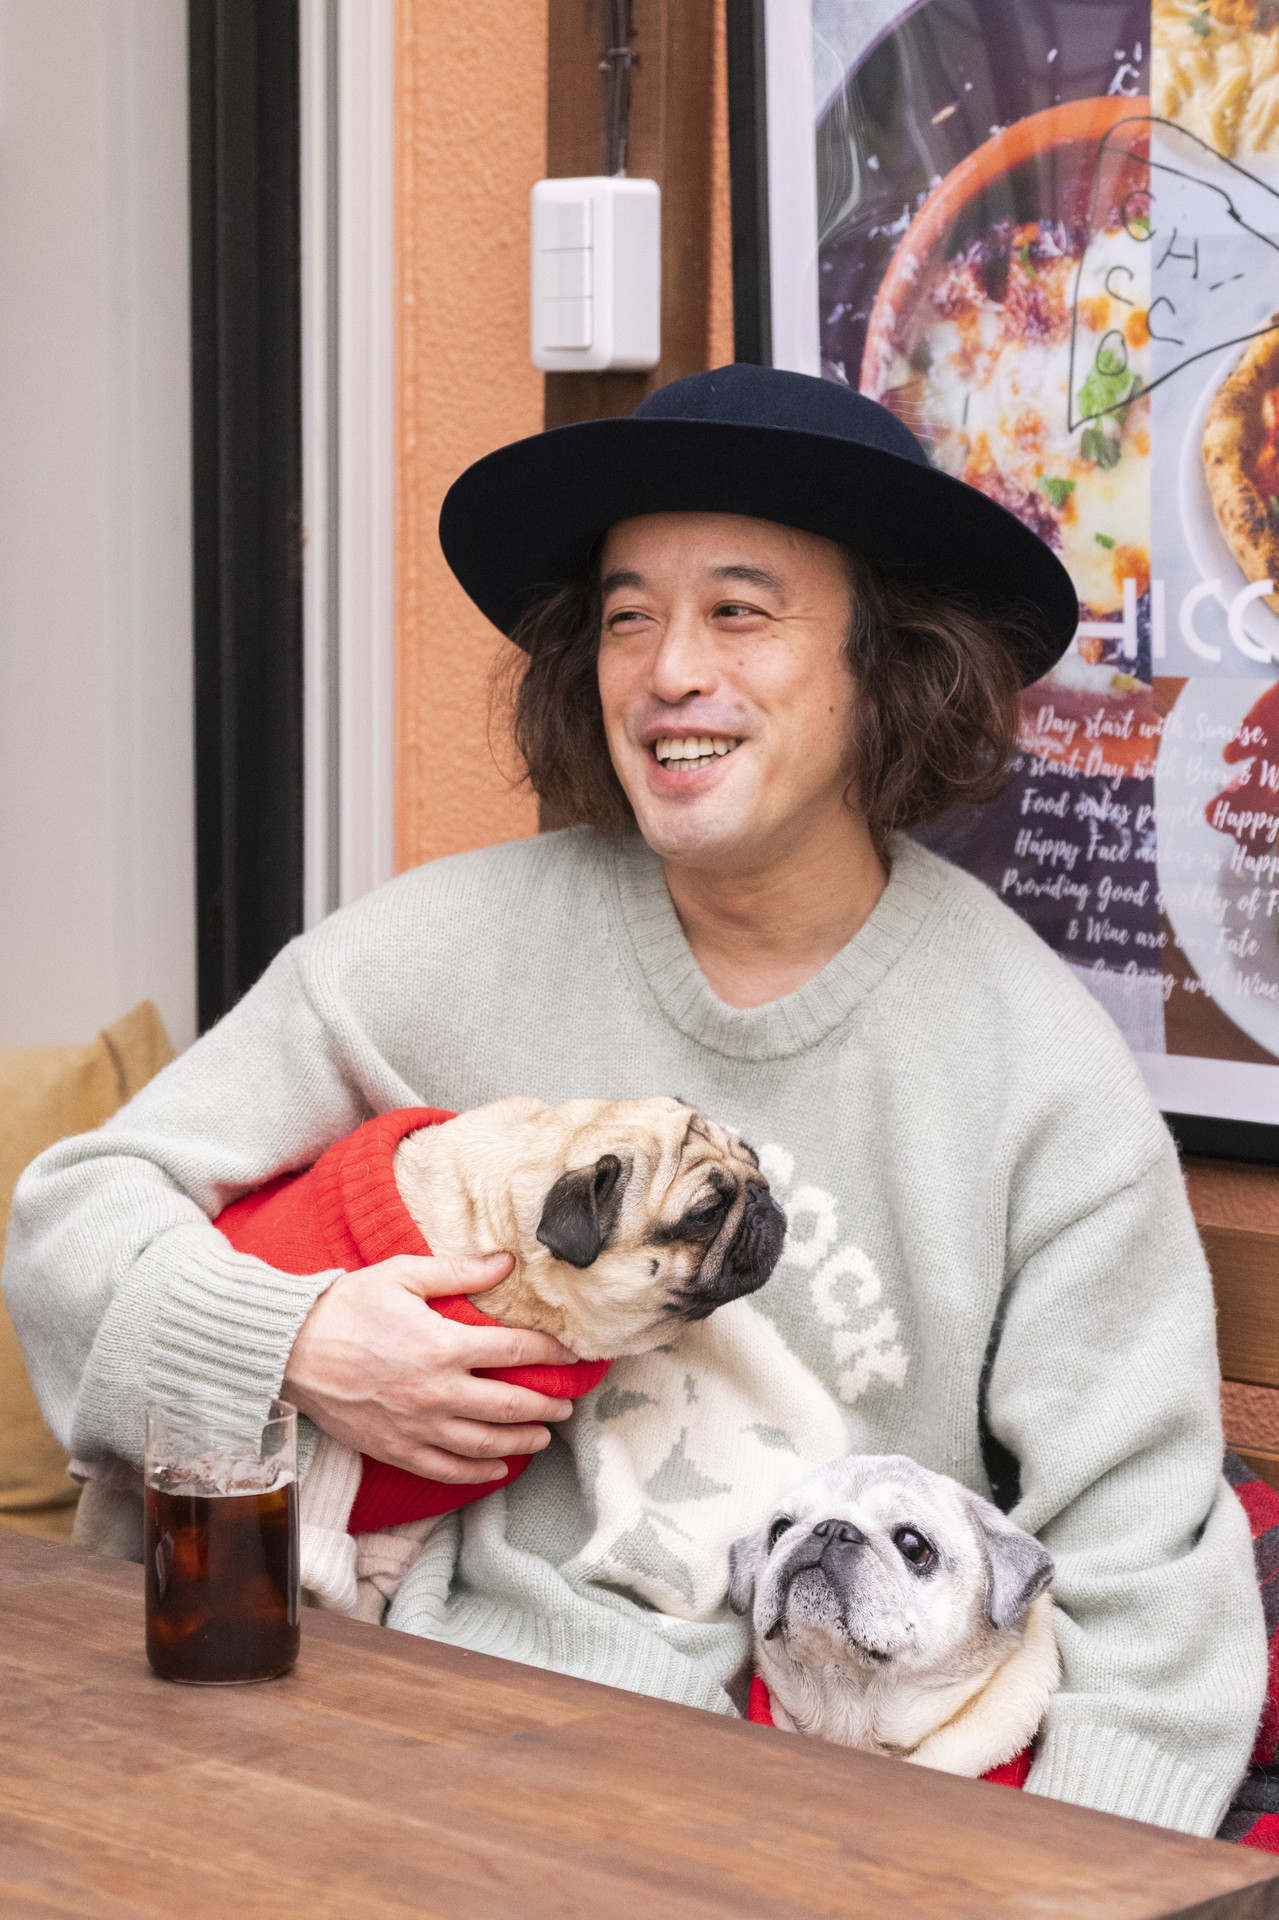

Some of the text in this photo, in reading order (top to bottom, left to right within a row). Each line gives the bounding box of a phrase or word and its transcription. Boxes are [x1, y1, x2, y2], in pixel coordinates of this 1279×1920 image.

[1036, 704, 1079, 746] Day
[1083, 708, 1134, 740] start
[1029, 747, 1080, 778] start
[1084, 746, 1127, 791] Day
[1020, 788, 1069, 818] Food
[1074, 786, 1132, 825] makes
[1212, 800, 1279, 843] Happy
[1014, 828, 1081, 870] Happy
[1086, 834, 1130, 862] Face
[1001, 868, 1092, 911] Providing
[1096, 875, 1149, 912] Good
[1237, 887, 1261, 921] of
[1066, 918, 1080, 941] &
[1085, 916, 1130, 945] Wine
[1135, 929, 1168, 948] are
[1216, 927, 1260, 958] Fate
[759, 1142, 909, 1403] OCK
